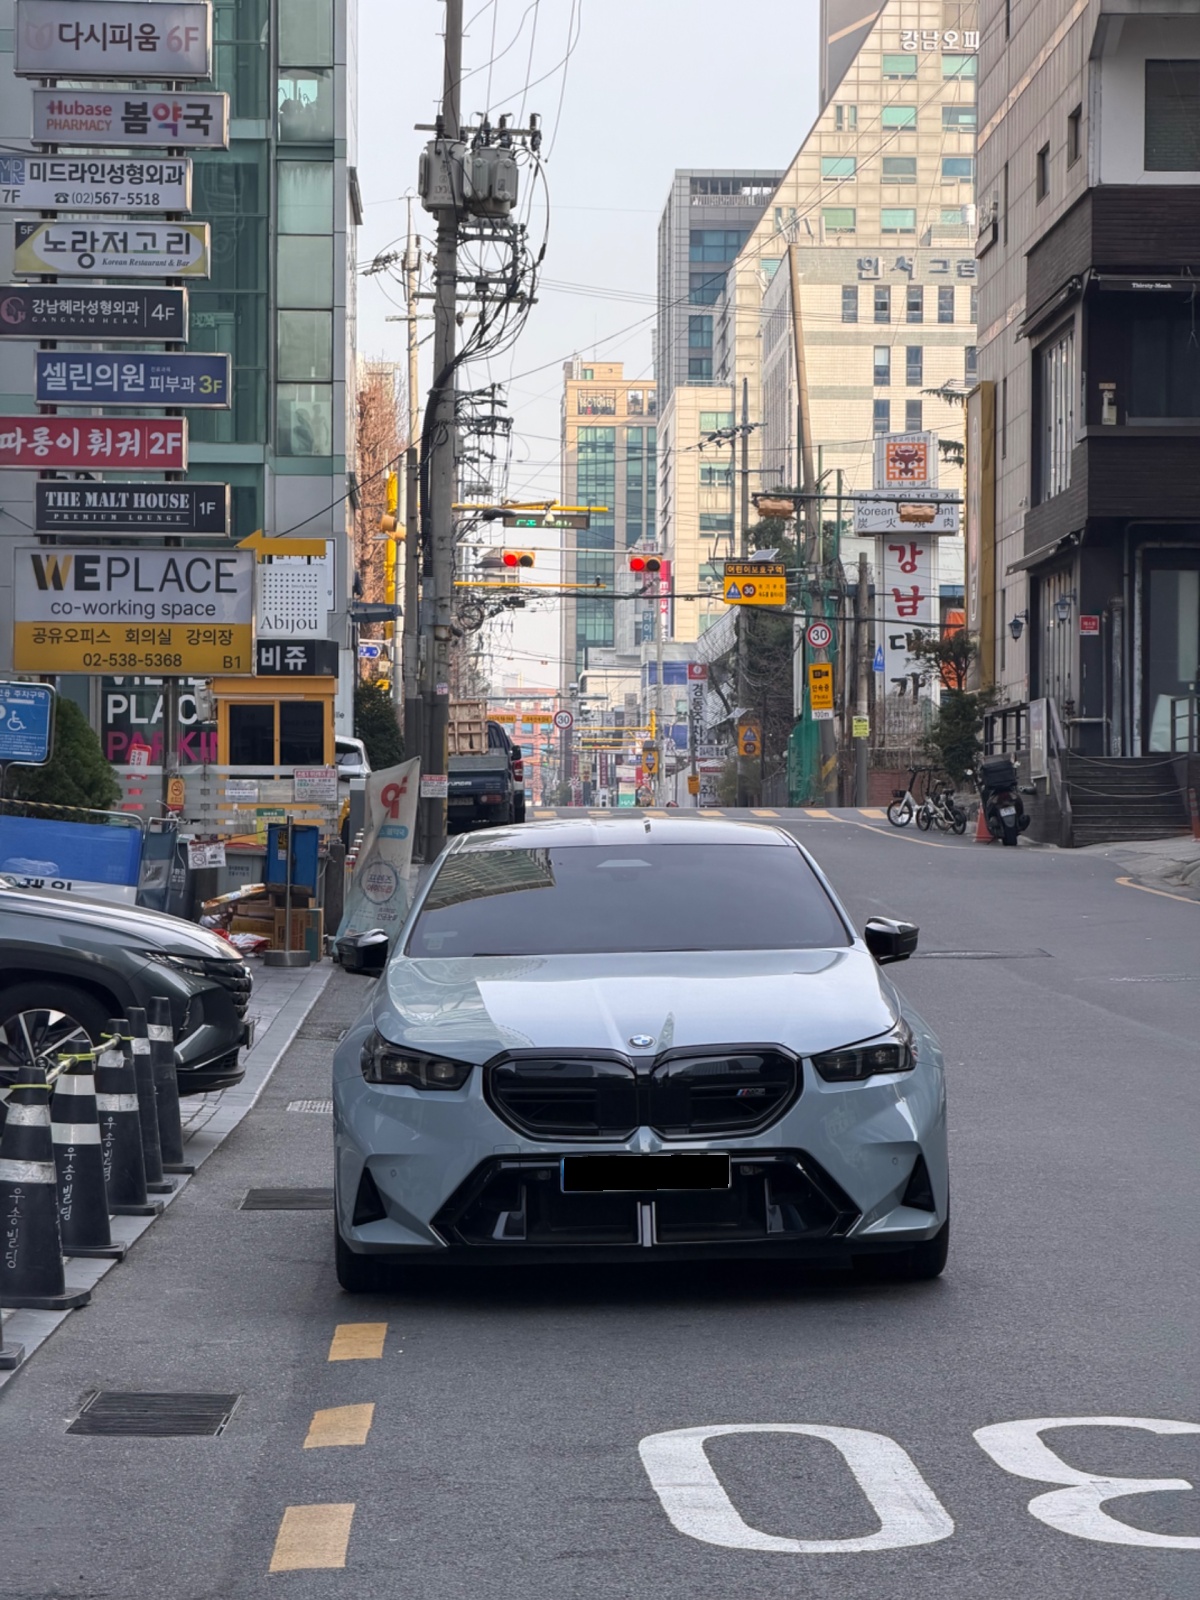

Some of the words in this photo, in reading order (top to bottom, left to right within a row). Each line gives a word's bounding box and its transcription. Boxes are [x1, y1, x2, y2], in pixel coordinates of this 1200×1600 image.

[58, 21, 161, 52] 다시피움
[166, 25, 199, 52] 6F
[46, 100, 113, 116] Hubase
[46, 118, 112, 131] PHARMACY
[121, 101, 213, 137] 봄약국
[29, 162, 185, 186] 미드라인성형외과
[2, 189, 21, 204] 7F
[72, 192, 160, 205] (02)567-5518
[20, 226, 34, 235] 5F
[43, 230, 191, 269] 노랑저고리
[102, 258, 128, 267] Korean
[129, 258, 167, 267] Restaurant
[176, 259, 190, 267] Bar
[32, 299, 140, 316] 강남헤라성형외과
[151, 303, 175, 321] 4F
[32, 316, 95, 324] GANGNAM
[102, 317, 139, 325] HERA
[42, 362, 145, 392] 셀린의원
[150, 375, 196, 393] 피부과
[199, 375, 223, 394] 3F
[0, 426, 80, 457] 따롱이
[87, 428, 141, 457] 훠궈
[150, 432, 181, 455] 2F
[45, 491, 81, 507] THE
[85, 492, 129, 508] MALT
[133, 493, 190, 509] HOUSE
[199, 502, 216, 515] 1F
[54, 513, 118, 521] PREMIUM
[857, 507, 894, 516] Korean
[30, 553, 238, 593] WEPLACE
[744, 586, 755, 595] 30
[50, 600, 156, 619] co-working
[160, 601, 217, 619] space
[260, 615, 318, 634] Abijou
[32, 627, 111, 644] 공유오피스
[124, 628, 173, 646] 회의실
[186, 628, 234, 646] 강의장
[811, 629, 827, 641] 30
[82, 652, 182, 668] 02-538-5368
[223, 655, 242, 669] B1
[14, 689, 46, 700] 주차구역
[557, 716, 570, 724] 30
[60, 1147, 77, 1221] 우송빌딩
[5, 1188, 26, 1269] 우송빌딩
